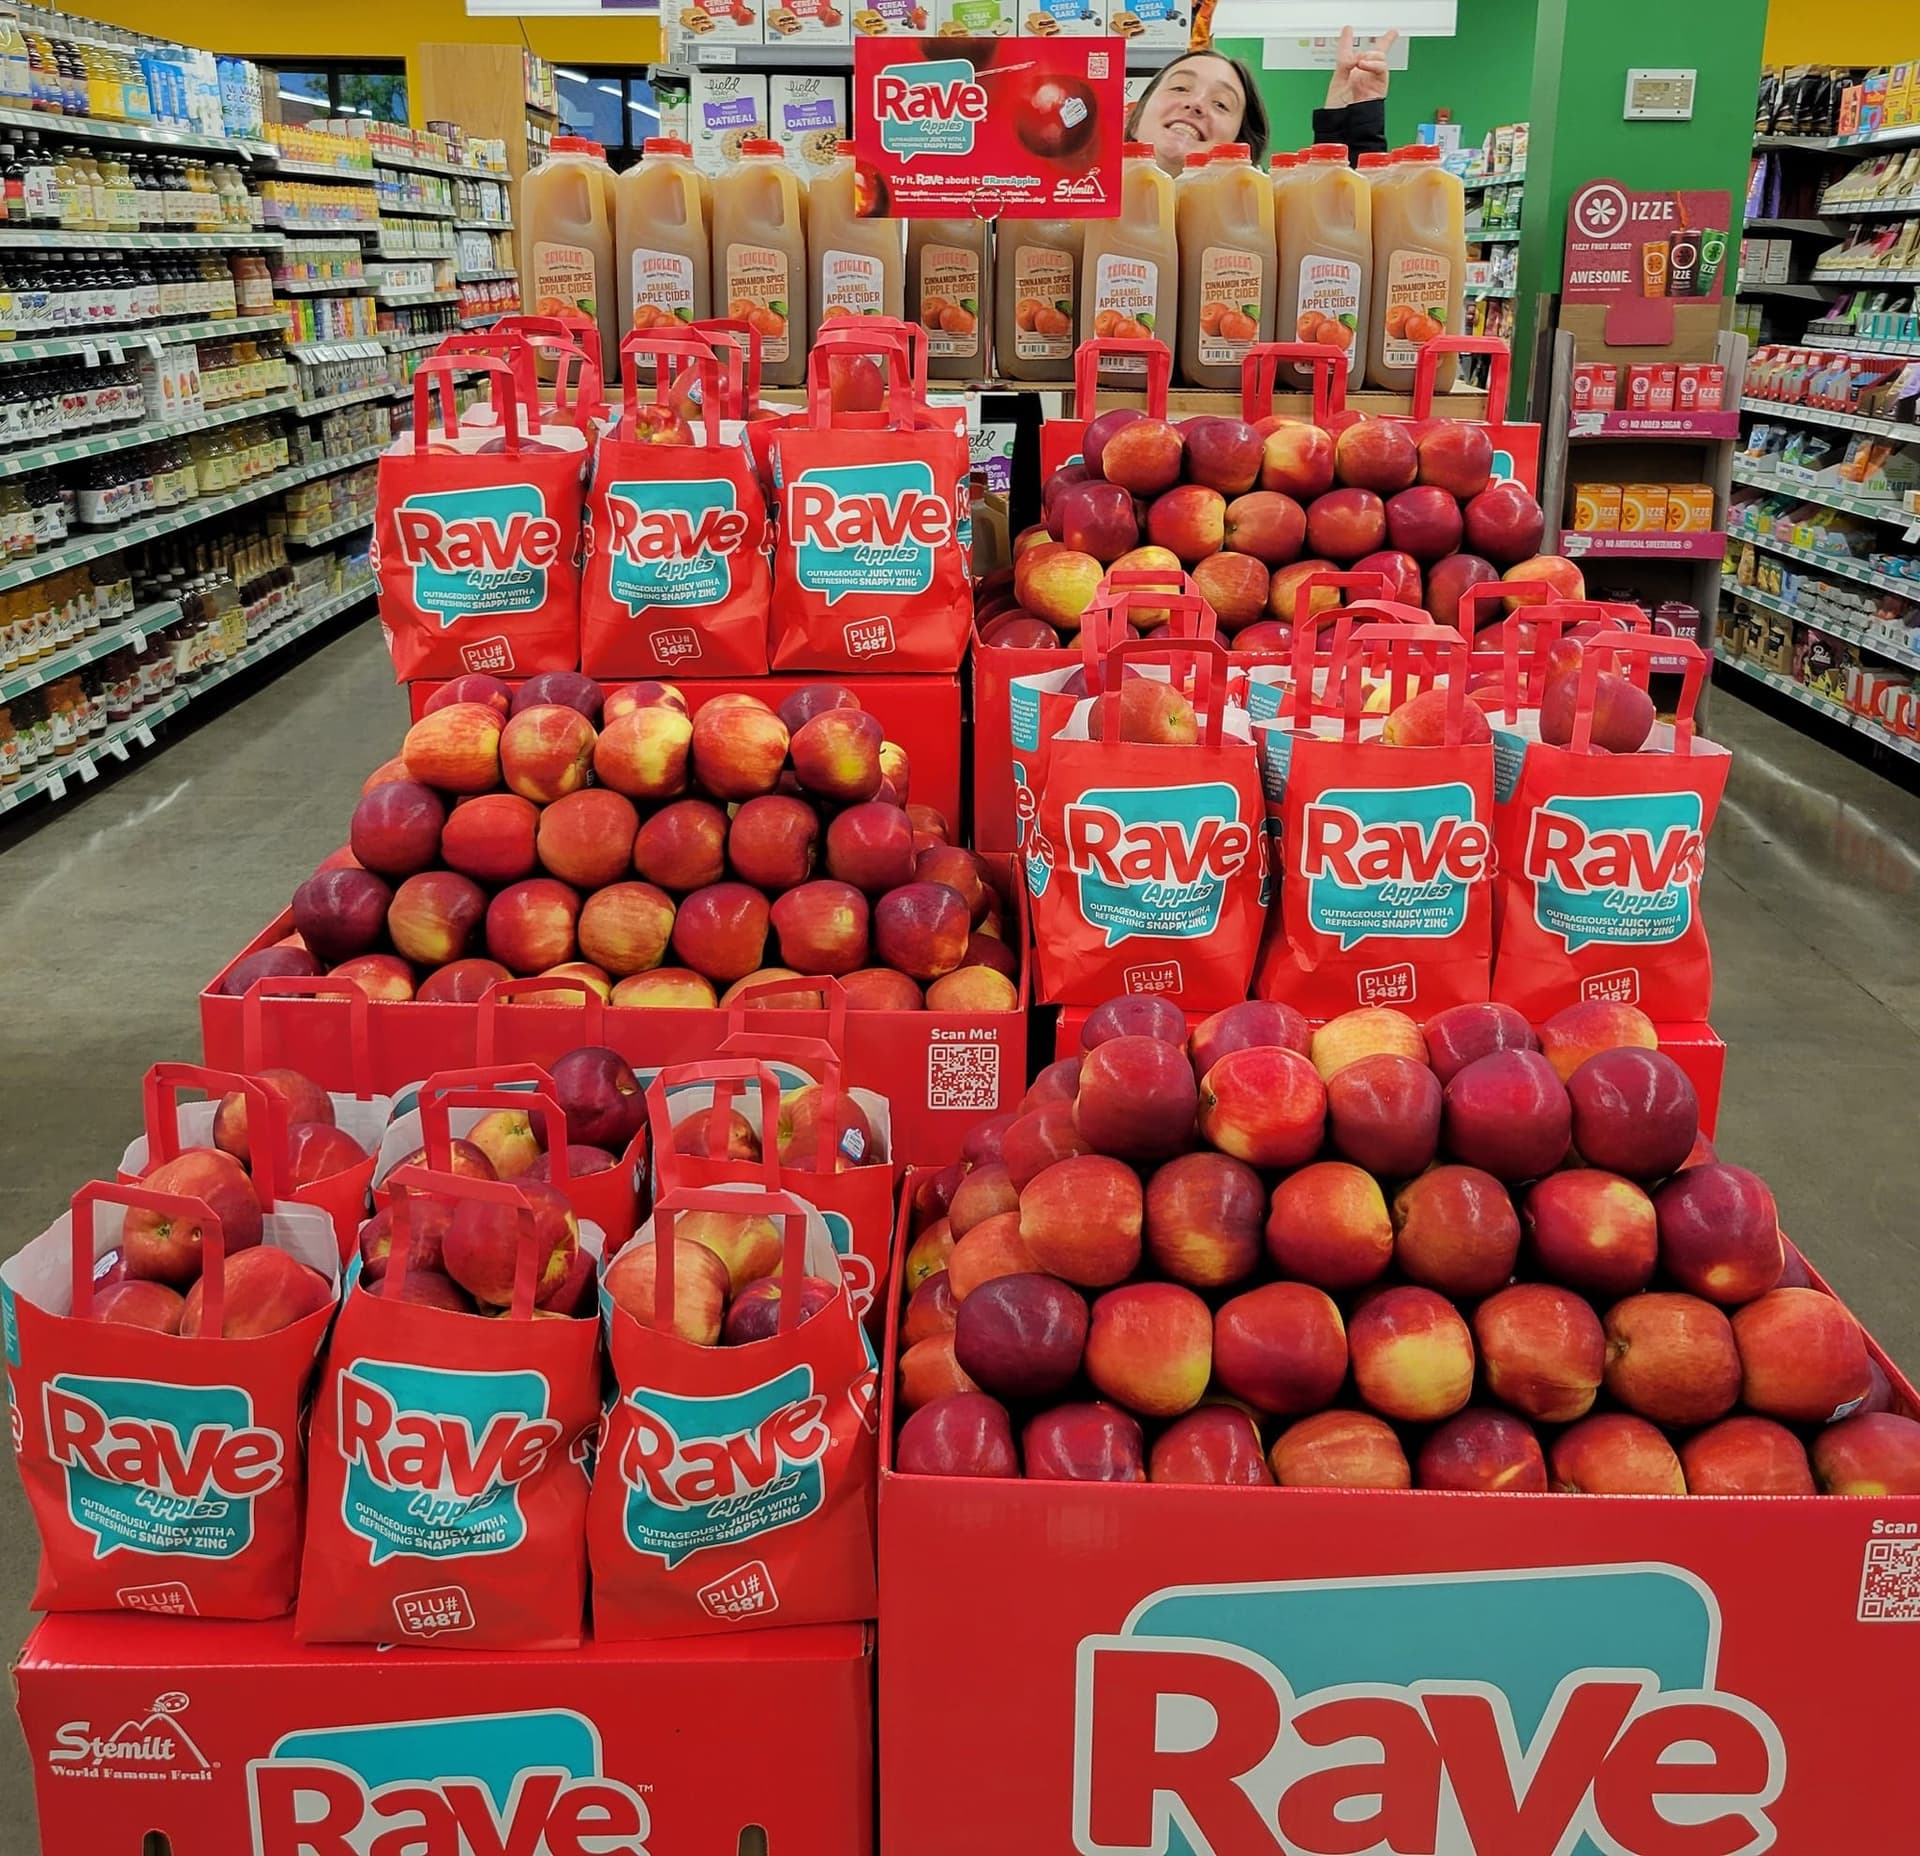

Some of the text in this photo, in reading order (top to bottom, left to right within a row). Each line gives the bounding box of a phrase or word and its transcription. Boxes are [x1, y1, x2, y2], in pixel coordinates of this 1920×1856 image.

[1134, 0, 1164, 11] CEREAL
[1140, 9, 1162, 19] BARS
[874, 75, 987, 122] Rave
[707, 114, 754, 127] OATMEAL
[787, 115, 834, 128] OATMEAL
[920, 119, 963, 134] Apples
[890, 176, 905, 186] Try
[915, 173, 944, 185] Rave
[945, 176, 970, 185] about
[982, 177, 1041, 187] #RaveApples
[1632, 202, 1673, 220] IZZE
[1572, 243, 1632, 251] FIZZY FRUIT JUICE?
[1570, 271, 1632, 283] AWESOME.
[1672, 270, 1692, 279] IZZE
[1700, 264, 1718, 274] IZZE
[539, 272, 593, 285] CINNAMON SPICE
[731, 273, 785, 287] CINNAMON SPICE
[924, 273, 976, 285] CINNAMON SPICE
[1019, 275, 1071, 287] CINNAMON SPICE
[1205, 277, 1260, 290] CINNAMON SPICE
[1392, 280, 1447, 292] CINNAMON SPICE
[539, 282, 593, 296] APPLE CIDER
[637, 290, 690, 303] APPLE CIDER
[732, 284, 785, 297] APPLE CIDER
[925, 283, 976, 296] APPLE CIDER
[1020, 284, 1071, 297] APPLE CIDER
[1205, 287, 1259, 301] APPLE CIDER
[1391, 290, 1446, 304] APPLE CIDER
[827, 291, 880, 304] APPLE CIDER
[1100, 296, 1153, 308] APPLE CIDER
[1302, 296, 1356, 309] APPLE CIDER
[1593, 387, 1616, 398] IZZE
[1651, 388, 1673, 398] IZZE
[1699, 388, 1721, 398] IZZE
[788, 483, 951, 552] Rave
[605, 492, 749, 567] Rave
[394, 508, 561, 574] Rave
[854, 546, 918, 565] Apples
[656, 557, 718, 580] Apples
[806, 569, 894, 578] OUTRAGEOUSLY JUICY
[467, 569, 532, 589] Apples
[811, 577, 917, 587] REFRESHING SNAPPY ZING
[850, 625, 886, 642] PLU#
[1677, 627, 1697, 637] IZZE
[467, 645, 503, 662] PLU#
[659, 645, 693, 657] 3487
[853, 637, 888, 654] 3487
[471, 656, 506, 671] 3487
[1064, 803, 1250, 888] Rave
[1301, 803, 1490, 887] Rave
[1142, 882, 1214, 907] Apples
[1379, 880, 1451, 906] Apples
[1604, 888, 1679, 914] Apples
[1090, 902, 1188, 922] OUTRAGEOUSLY JUICY
[1320, 908, 1446, 919] OUTRAGEOUSLY JUICY WITH
[1546, 909, 1674, 928] OUTRAGEOUSLY JUICY WITH
[1095, 911, 1207, 931] REFRESHING SNAPPY ZING
[1325, 917, 1448, 929] REFRESHING SNAPPY ZING
[1551, 918, 1674, 937] REFRESHING SNAPPY ZING
[1131, 970, 1174, 984] PLU#
[1365, 973, 1407, 989] PLU#
[1133, 980, 1174, 993] 3487
[1366, 986, 1407, 999] 3487
[1589, 977, 1631, 994] PLU#
[931, 1028, 997, 1040] Scan Me!
[42, 1382, 284, 1498] Rave
[338, 1368, 563, 1499] Rave
[620, 1394, 830, 1510] Rave
[707, 1471, 801, 1518] Apples
[135, 1488, 229, 1521] Apples
[80, 1497, 225, 1538] OUTRAGEOUSLY JUICY WITH
[355, 1503, 497, 1540] OUTRAGEOUSLY JUICY WITH
[638, 1495, 797, 1541] OUTRAGEOUSLY JUICY WITH
[84, 1509, 227, 1550] REFRESHING SNAPPY ZING
[359, 1515, 505, 1551] REFRESHING SNAPPY ZING
[643, 1504, 800, 1549] REFRESHING SNAPPY ZING
[1871, 1519, 1918, 1534] Scan
[707, 1573, 760, 1606] PLU#
[127, 1592, 181, 1608] PLU#
[403, 1596, 458, 1619] PLU#
[714, 1591, 764, 1615] 3487
[408, 1611, 462, 1631] 3487
[48, 1721, 176, 1766] Stemilt
[1073, 1634, 1786, 1856] Rave
[50, 1765, 213, 1781] World Famous Fruit
[244, 1757, 651, 1856] Rave
